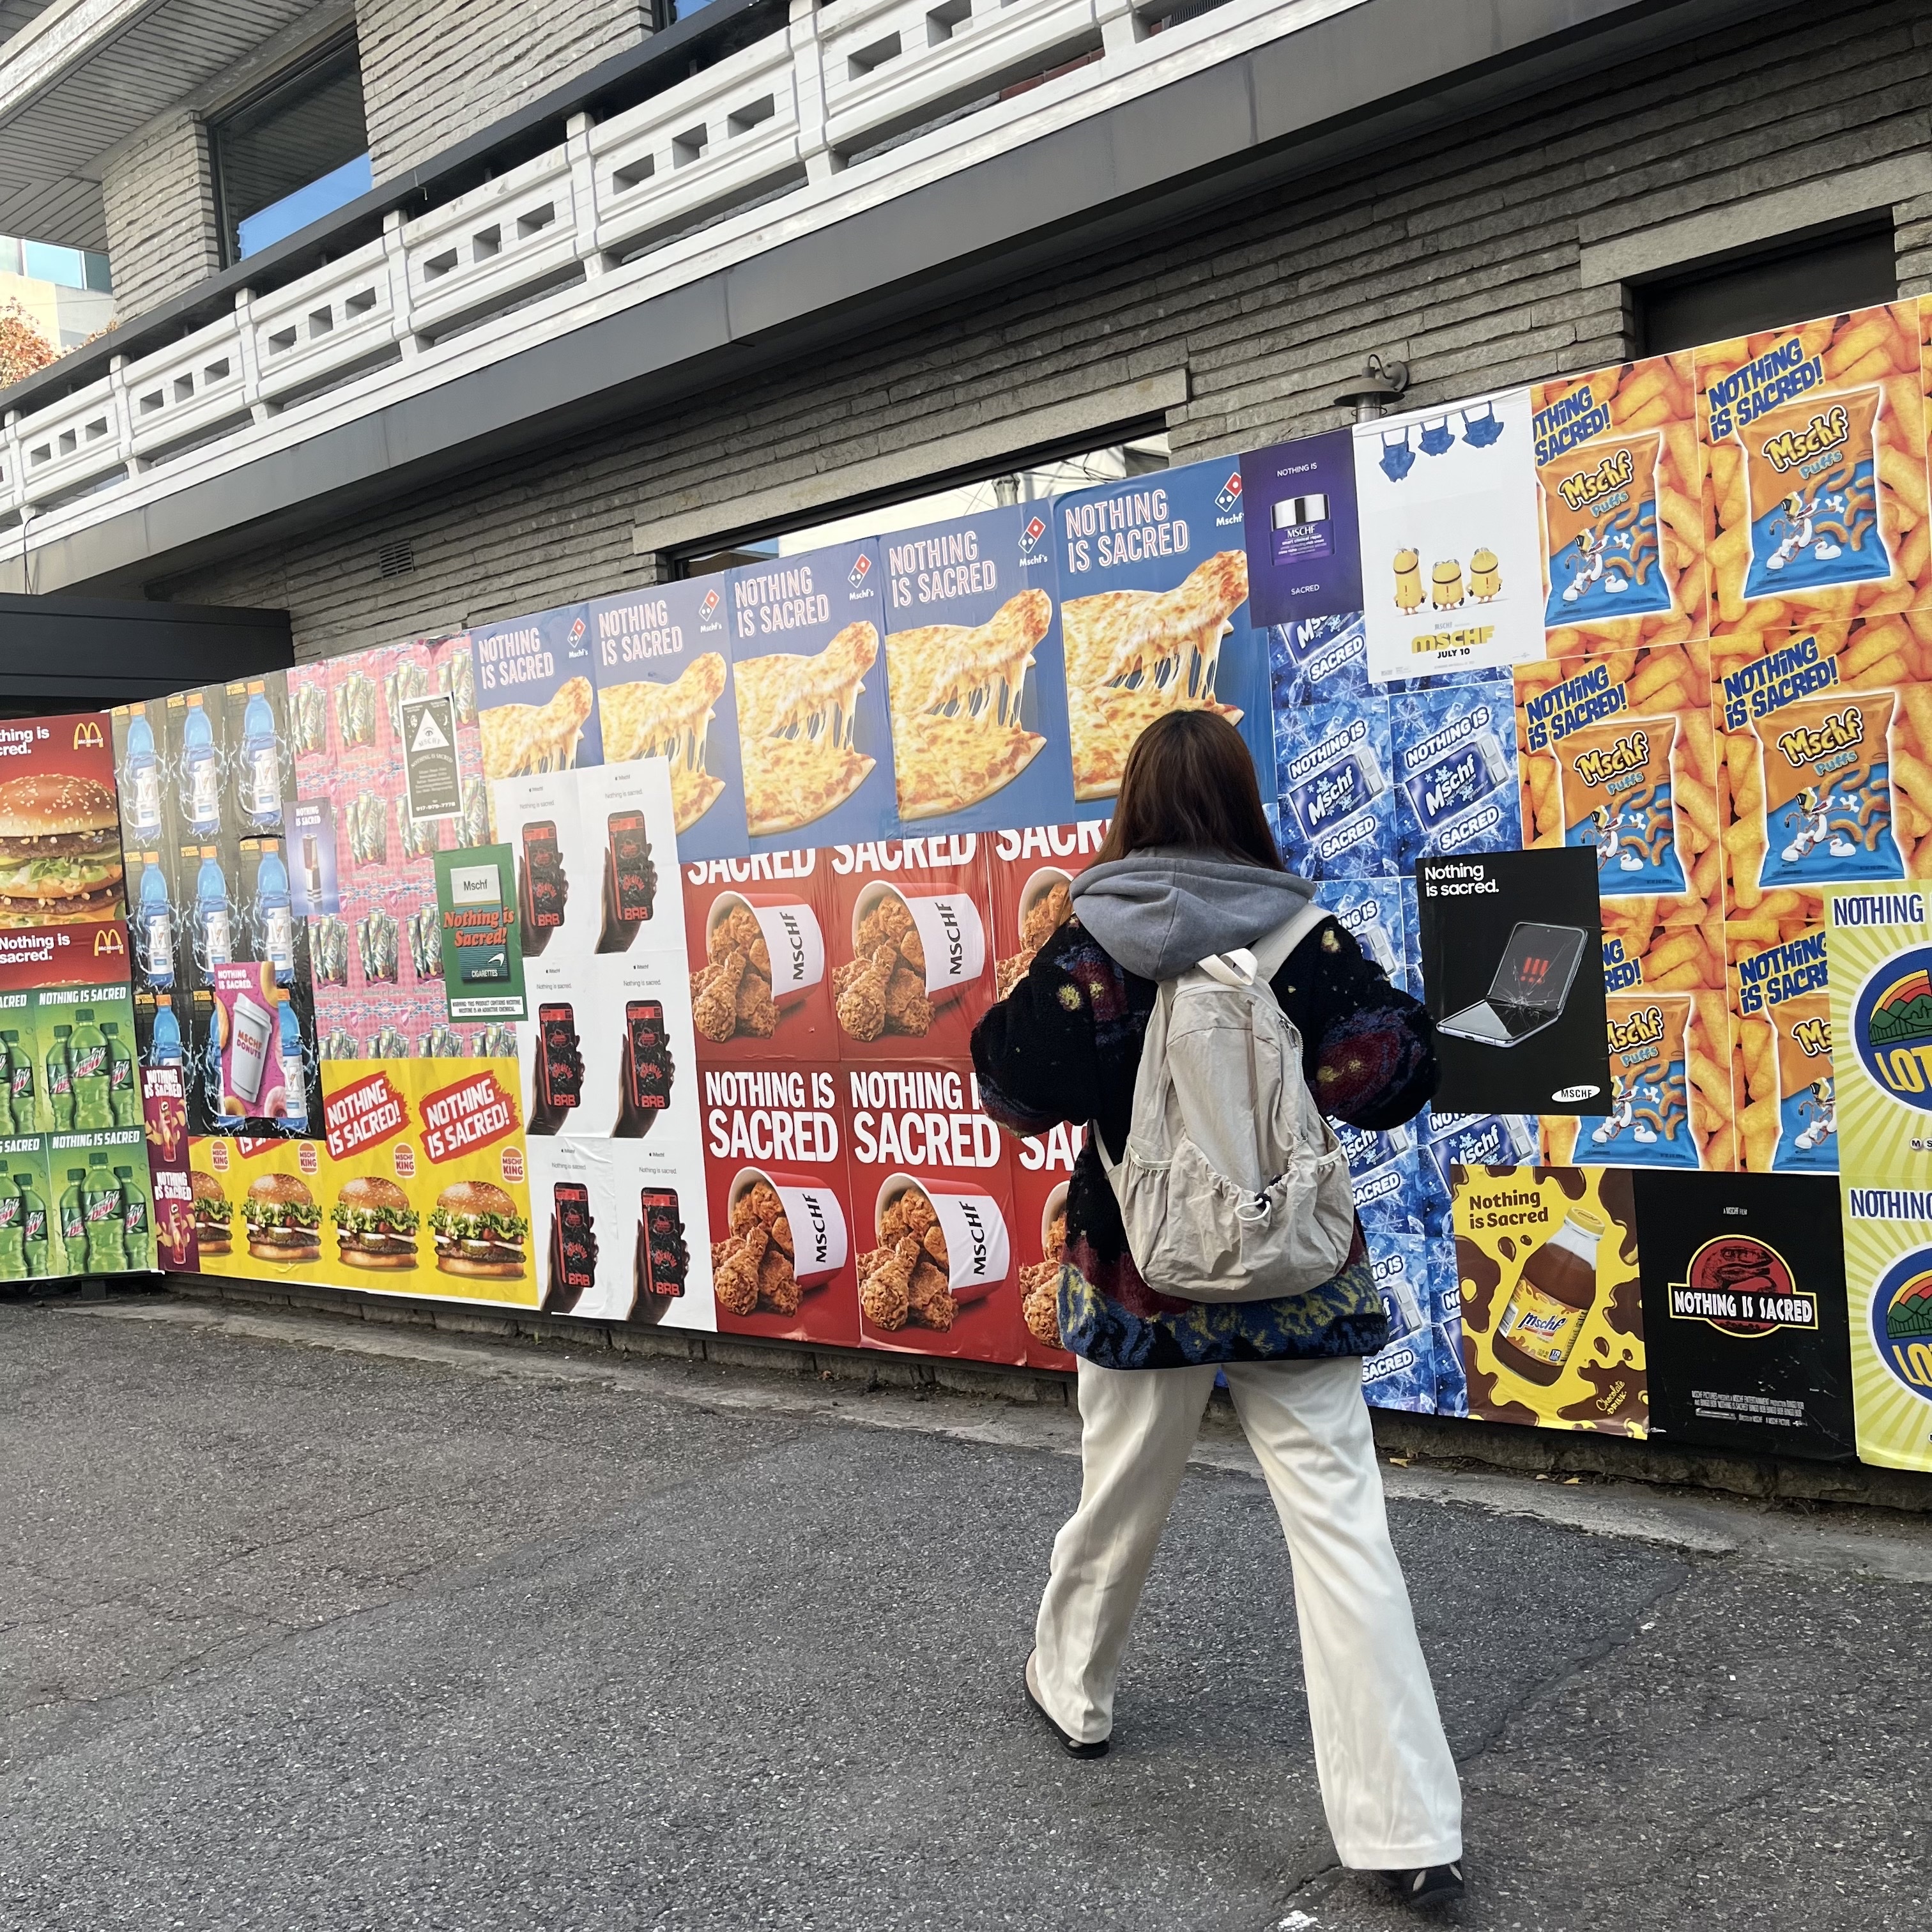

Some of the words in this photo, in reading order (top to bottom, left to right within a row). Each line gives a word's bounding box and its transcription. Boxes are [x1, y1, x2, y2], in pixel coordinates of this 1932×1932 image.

[1735, 355, 1825, 429] SACRED!
[1535, 402, 1611, 466] SACRED!
[1762, 405, 1849, 472] Mschf
[1277, 464, 1310, 477] NOTHING
[1559, 450, 1634, 510] Mschf
[1065, 489, 1169, 540] NOTHING
[1068, 540, 1091, 574] IS
[1098, 519, 1190, 567] SACRED
[1287, 525, 1315, 538] MSCHF
[889, 530, 978, 576] NOTHING
[734, 566, 813, 609] NOTHING
[891, 577, 911, 608] IS
[918, 560, 997, 604] SACRED
[1291, 585, 1320, 595] SACRED
[599, 600, 668, 638] NOTHING
[737, 610, 756, 638] IS
[760, 594, 830, 634] SACRED
[479, 627, 540, 663] NOTHING
[601, 638, 618, 666] IS
[622, 625, 683, 663] SACRED
[1310, 635, 1365, 682] SACRED
[1438, 649, 1457, 659] JULY
[481, 663, 496, 689] IS
[500, 652, 555, 686] SACRED
[1752, 656, 1839, 717] SACRED!
[1550, 683, 1627, 741] SACRED!
[36, 726, 50, 739] is
[1406, 716, 1472, 768] NOTHING
[1471, 707, 1490, 730] IS
[1778, 707, 1864, 767] Mschf
[1290, 729, 1349, 779] NOTHING
[1348, 720, 1366, 744] IS
[1574, 732, 1649, 786] Mschf
[1308, 765, 1353, 825] Mschf
[1425, 754, 1474, 816] Mschf
[296, 806, 319, 816] NOTHING
[302, 815, 321, 825] SACRED
[1321, 816, 1376, 859] SACRED
[1439, 806, 1499, 852] SACRED
[687, 848, 816, 885] SACRED
[832, 832, 977, 874] SACRED
[463, 878, 487, 891] Mschf
[1425, 862, 1484, 882] Nothing
[1425, 884, 1438, 897] is
[1440, 879, 1499, 896] sacred.
[443, 909, 500, 929] Nothing
[502, 905, 515, 926] is
[537, 912, 560, 926] BRB
[624, 906, 648, 921] BRB
[1834, 894, 1924, 926] NOTHING
[0, 935, 55, 950] Nothing
[57, 933, 71, 946] is
[454, 926, 509, 948] Sacred!
[779, 911, 804, 981] MSCHF
[935, 901, 962, 975] MSCHF
[0, 947, 52, 964] sacred.
[218, 969, 247, 979] NOTHING
[218, 980, 225, 990] IS
[226, 979, 253, 990] SACRED.
[39, 991, 79, 1006] NOTHING
[80, 990, 89, 1002] IS
[91, 986, 126, 1002] SACRED
[236, 1040, 262, 1060] DONUTS
[238, 1030, 263, 1052] MSCHF
[145, 1084, 155, 1099] IS
[154, 1083, 182, 1098] SACRED
[146, 1069, 178, 1083] NOTHING
[705, 1071, 805, 1109] NOTHING
[811, 1072, 836, 1110] IS
[850, 1071, 963, 1110] NOTHING
[327, 1078, 388, 1130] NOTHING
[427, 1078, 495, 1130] NOTHING
[553, 1094, 576, 1107] BRB
[641, 1095, 665, 1108] BRB
[1560, 1088, 1593, 1099] MSCHF
[52, 1134, 92, 1149] NOTHING
[94, 1133, 103, 1146] IS
[104, 1130, 141, 1145] SACRED
[327, 1130, 344, 1156] IS
[344, 1100, 402, 1148] SACRED!
[427, 1131, 444, 1157] IS
[443, 1100, 511, 1149] SACRED!
[709, 1110, 839, 1163] SACRED
[854, 1111, 1001, 1168] SACRED
[4, 1138, 40, 1152] SACRED
[157, 1171, 187, 1186] NOTHING
[396, 1160, 415, 1170] KING
[503, 1165, 523, 1176] KING
[155, 1186, 164, 1200] IS
[164, 1186, 192, 1201] SACRED
[1469, 1190, 1541, 1211] Nothing
[802, 1193, 826, 1263] MSCHF
[1469, 1215, 1484, 1229] is
[1487, 1207, 1549, 1226] Sacred
[958, 1200, 985, 1276] MSCHF
[568, 1273, 590, 1285] BRB
[1386, 1255, 1403, 1274] IS
[656, 1282, 680, 1296] BRB
[1675, 1291, 1736, 1317] NOTHING
[1742, 1296, 1753, 1318] IS
[1759, 1298, 1813, 1322] SACRED
[1362, 1349, 1414, 1383] SACRED
[1596, 1379, 1625, 1411] Chocolate
